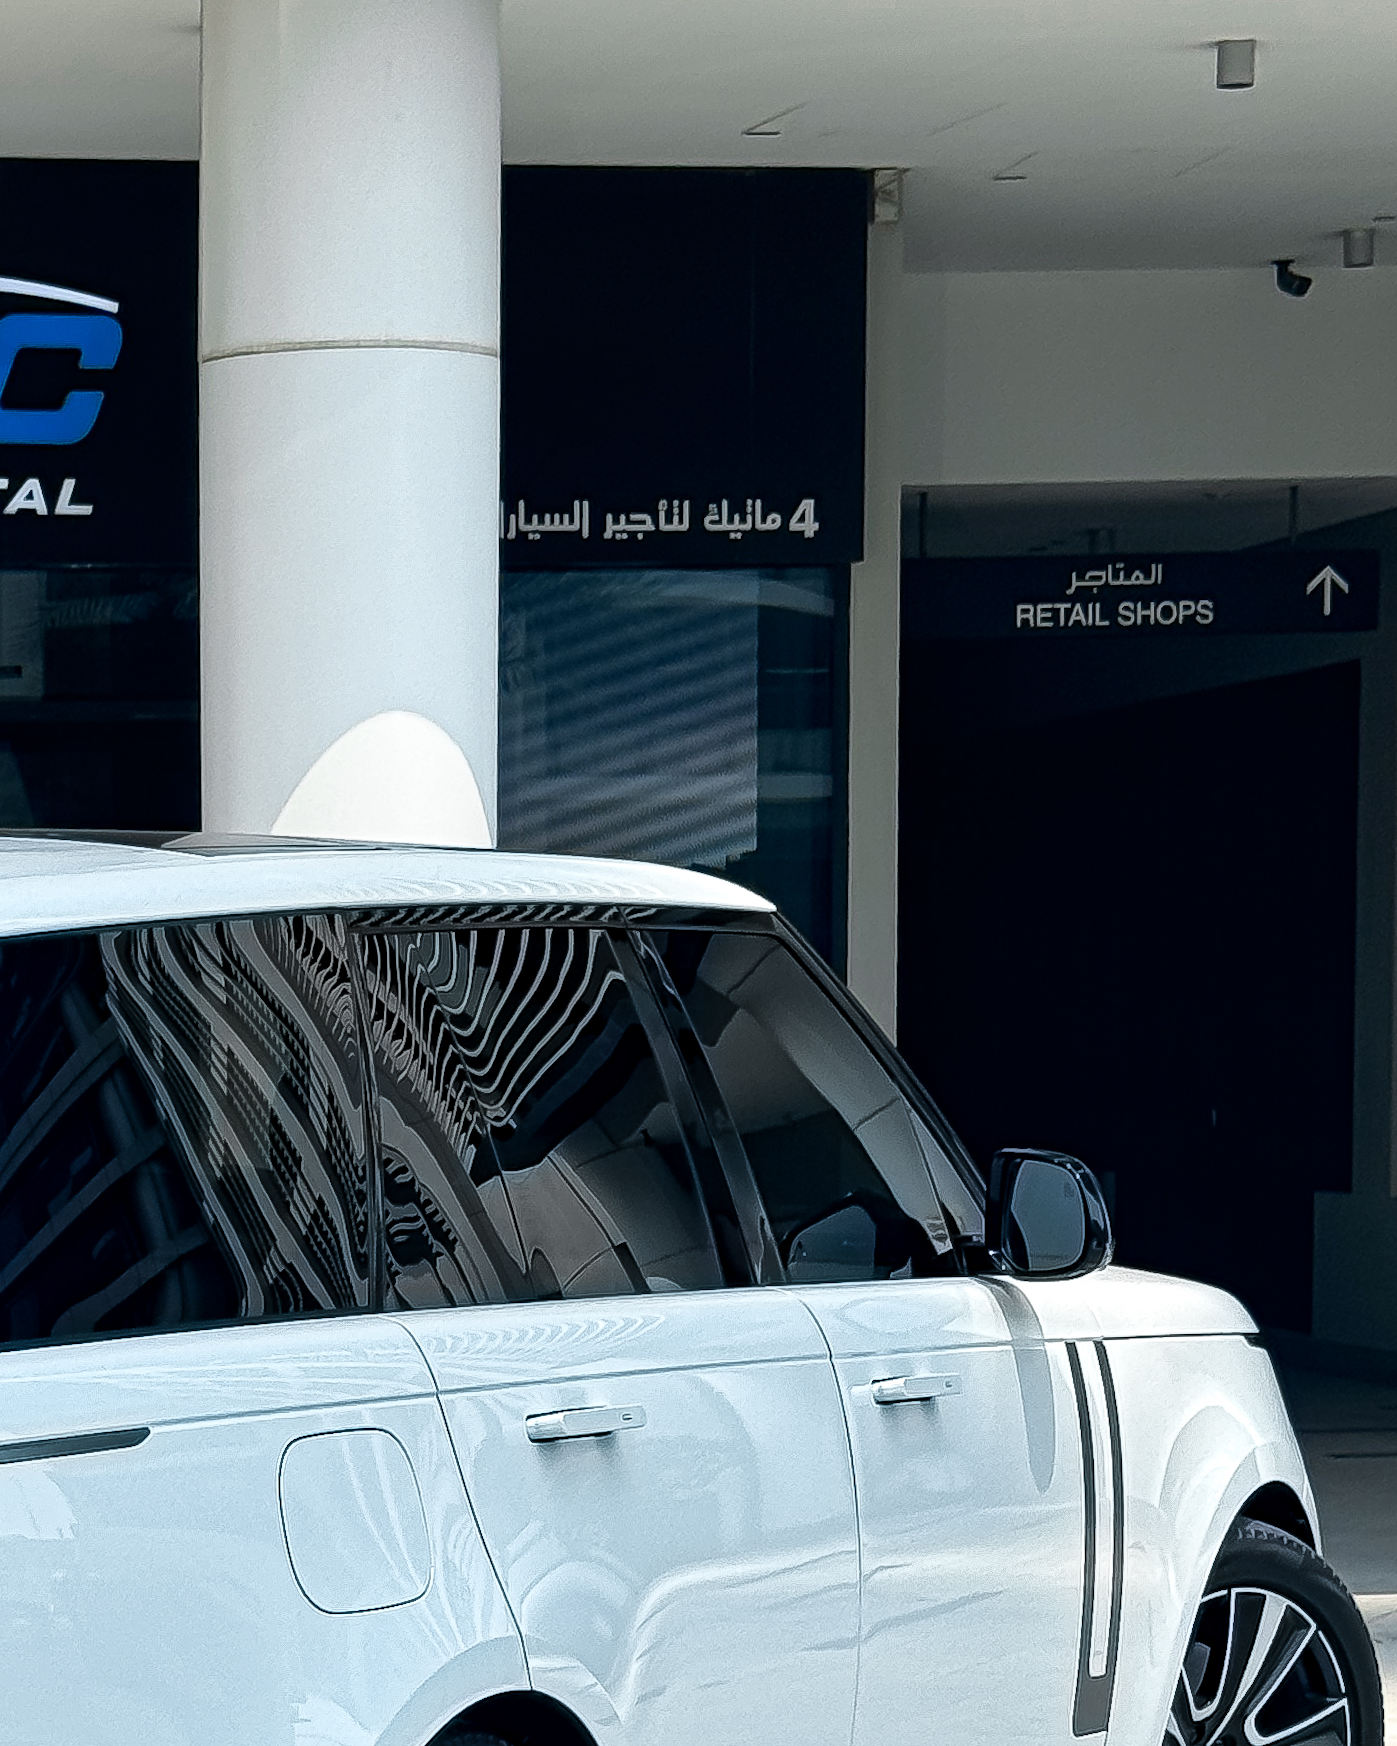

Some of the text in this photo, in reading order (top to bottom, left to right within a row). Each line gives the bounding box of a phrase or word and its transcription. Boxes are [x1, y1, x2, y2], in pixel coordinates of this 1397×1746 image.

[1065, 563, 1163, 595] المتاجر
[1016, 600, 1215, 628] RETAIL SHOPS
